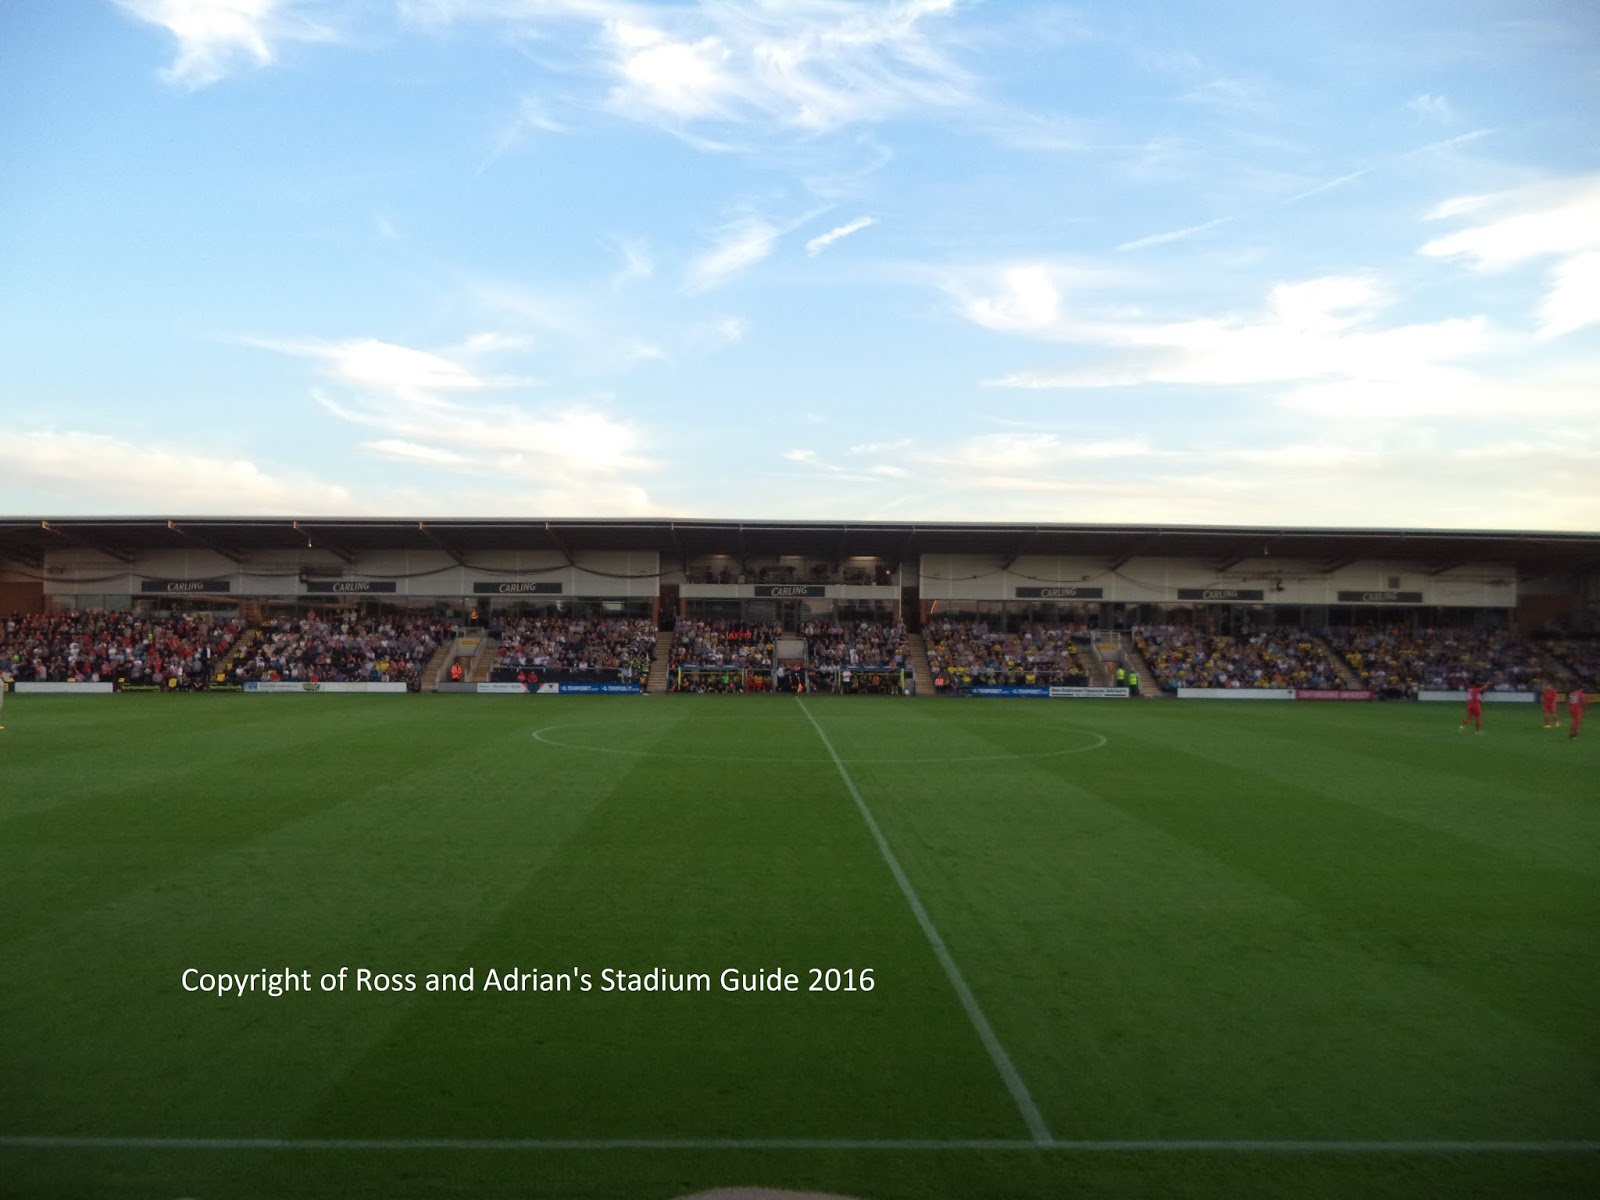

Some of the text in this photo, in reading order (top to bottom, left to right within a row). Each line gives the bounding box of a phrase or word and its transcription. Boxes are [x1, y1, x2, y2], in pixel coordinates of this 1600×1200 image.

[167, 582, 204, 592] CARLING
[333, 582, 370, 592] CARLING
[499, 582, 536, 593] CARLING
[771, 586, 807, 596] CARLING
[1041, 587, 1077, 598] CARLING
[1203, 589, 1238, 599] CARLING
